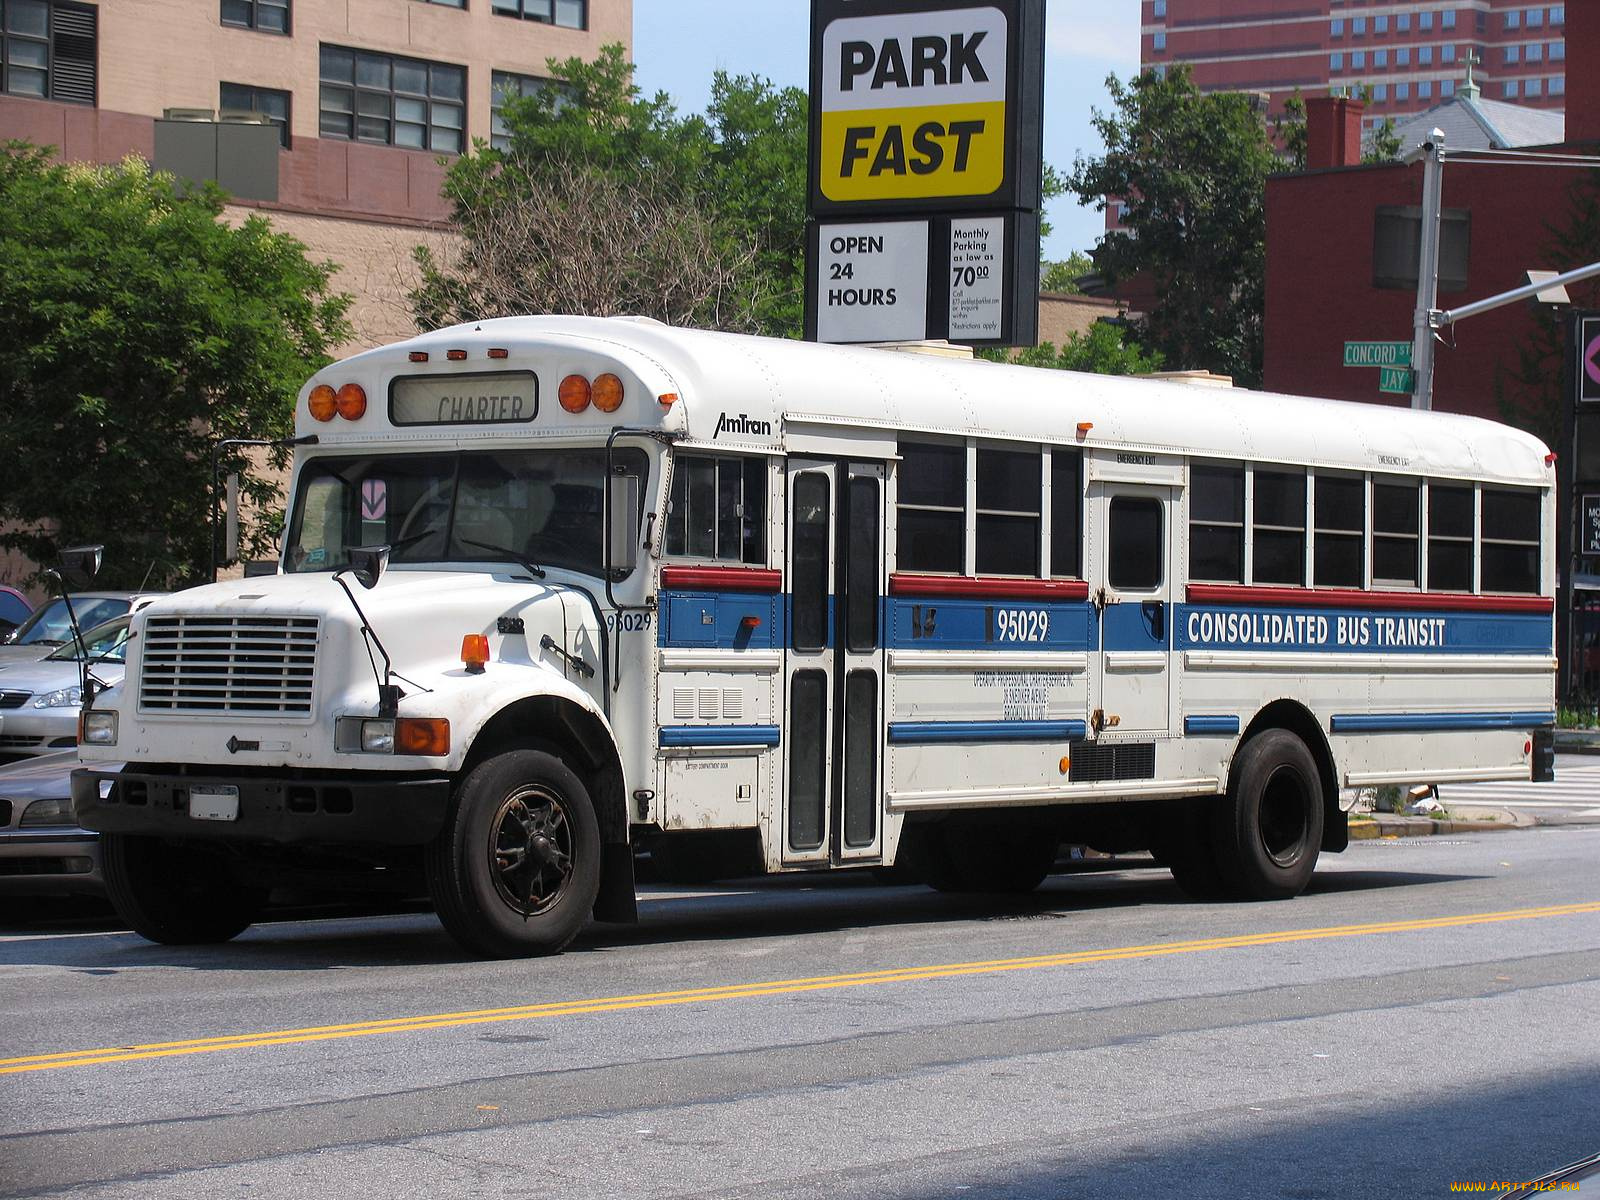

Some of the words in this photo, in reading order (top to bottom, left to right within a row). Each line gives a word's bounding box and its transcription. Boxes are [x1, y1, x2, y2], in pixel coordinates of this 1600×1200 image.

[840, 31, 989, 91] PARK
[839, 120, 985, 178] FAST
[953, 228, 989, 240] Monthly
[830, 236, 883, 254] OPEN
[953, 241, 987, 252] Parking
[966, 253, 981, 262] low
[830, 263, 853, 280] 24
[828, 288, 897, 306] HOURS
[952, 290, 963, 298] Call
[1345, 345, 1396, 364] CONCORD
[1399, 345, 1409, 355] ST
[1382, 370, 1404, 390] JAY
[438, 396, 523, 422] CHARTER
[713, 412, 771, 439] AmTran
[998, 609, 1048, 642] 95029
[1187, 612, 1328, 645] CONSOLIDATED
[1337, 615, 1369, 646] BUS
[1375, 617, 1446, 647] TRANSIT
